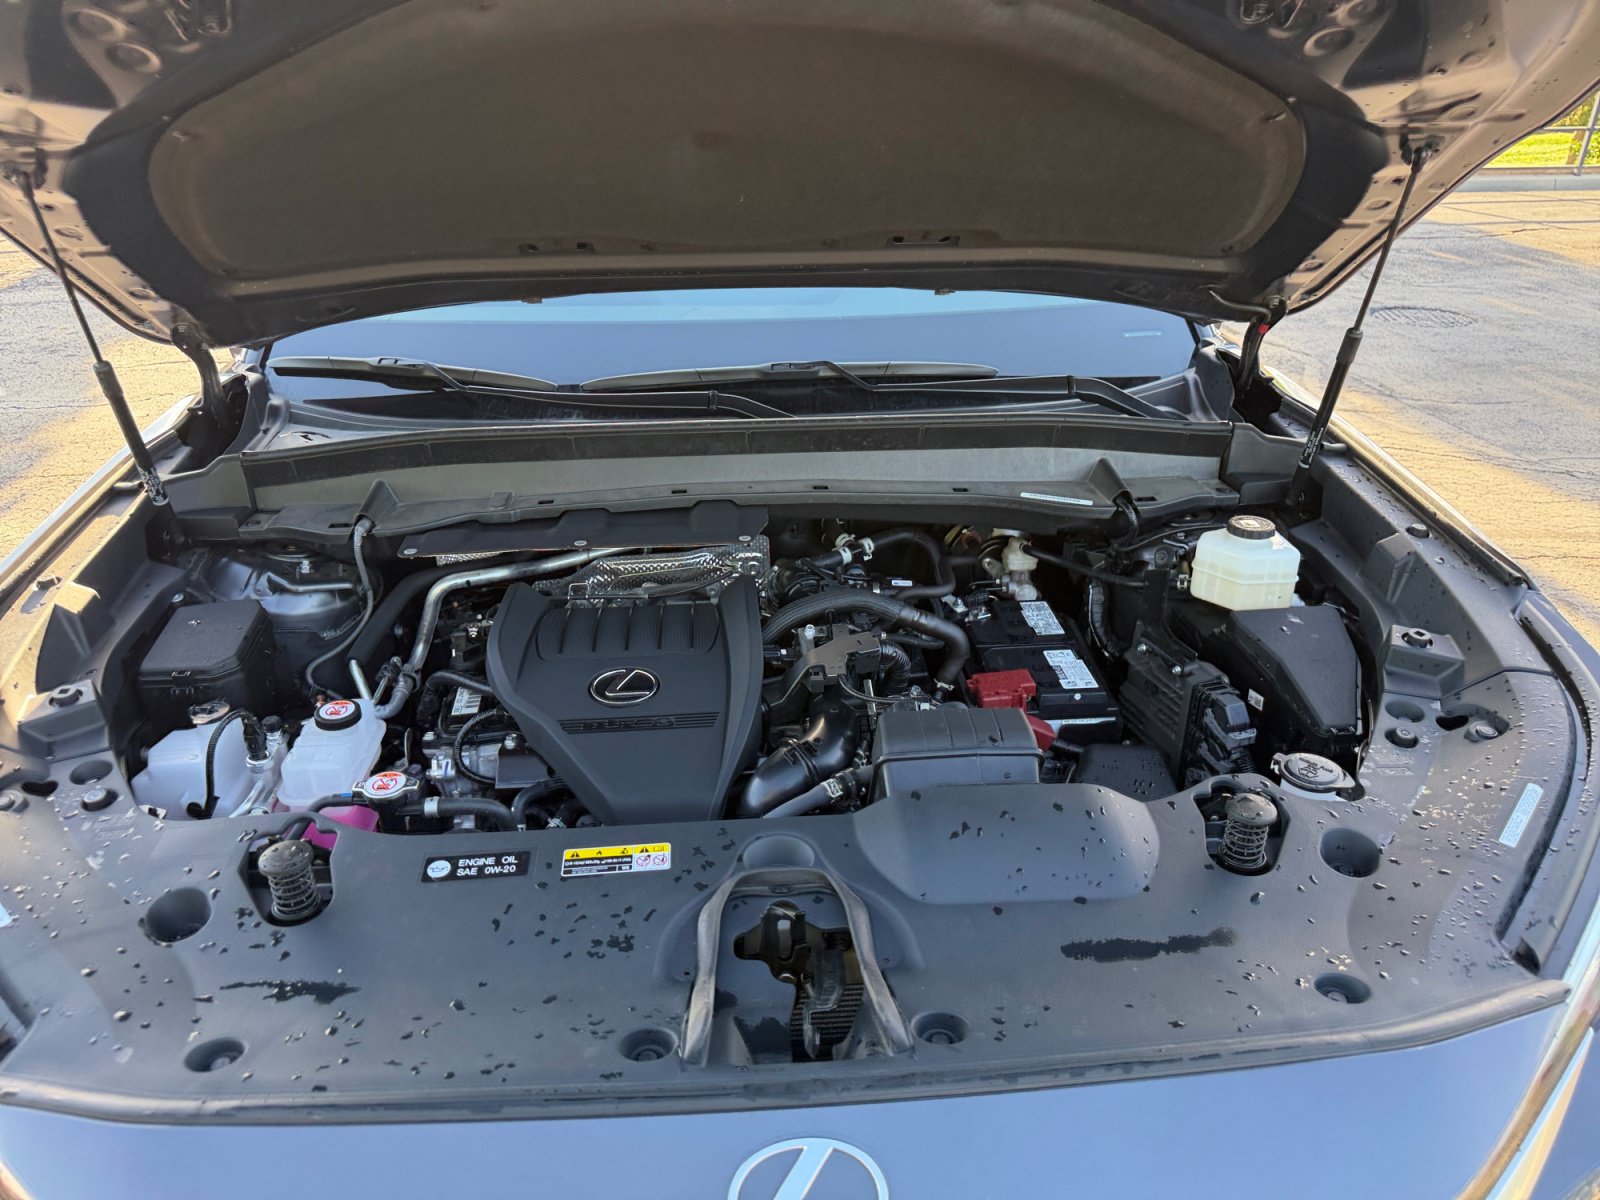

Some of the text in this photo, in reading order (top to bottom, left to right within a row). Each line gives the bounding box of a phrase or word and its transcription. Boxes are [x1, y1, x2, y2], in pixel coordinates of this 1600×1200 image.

[458, 855, 518, 867] ENGINE OIL
[456, 865, 516, 876] SAE 0W-20
